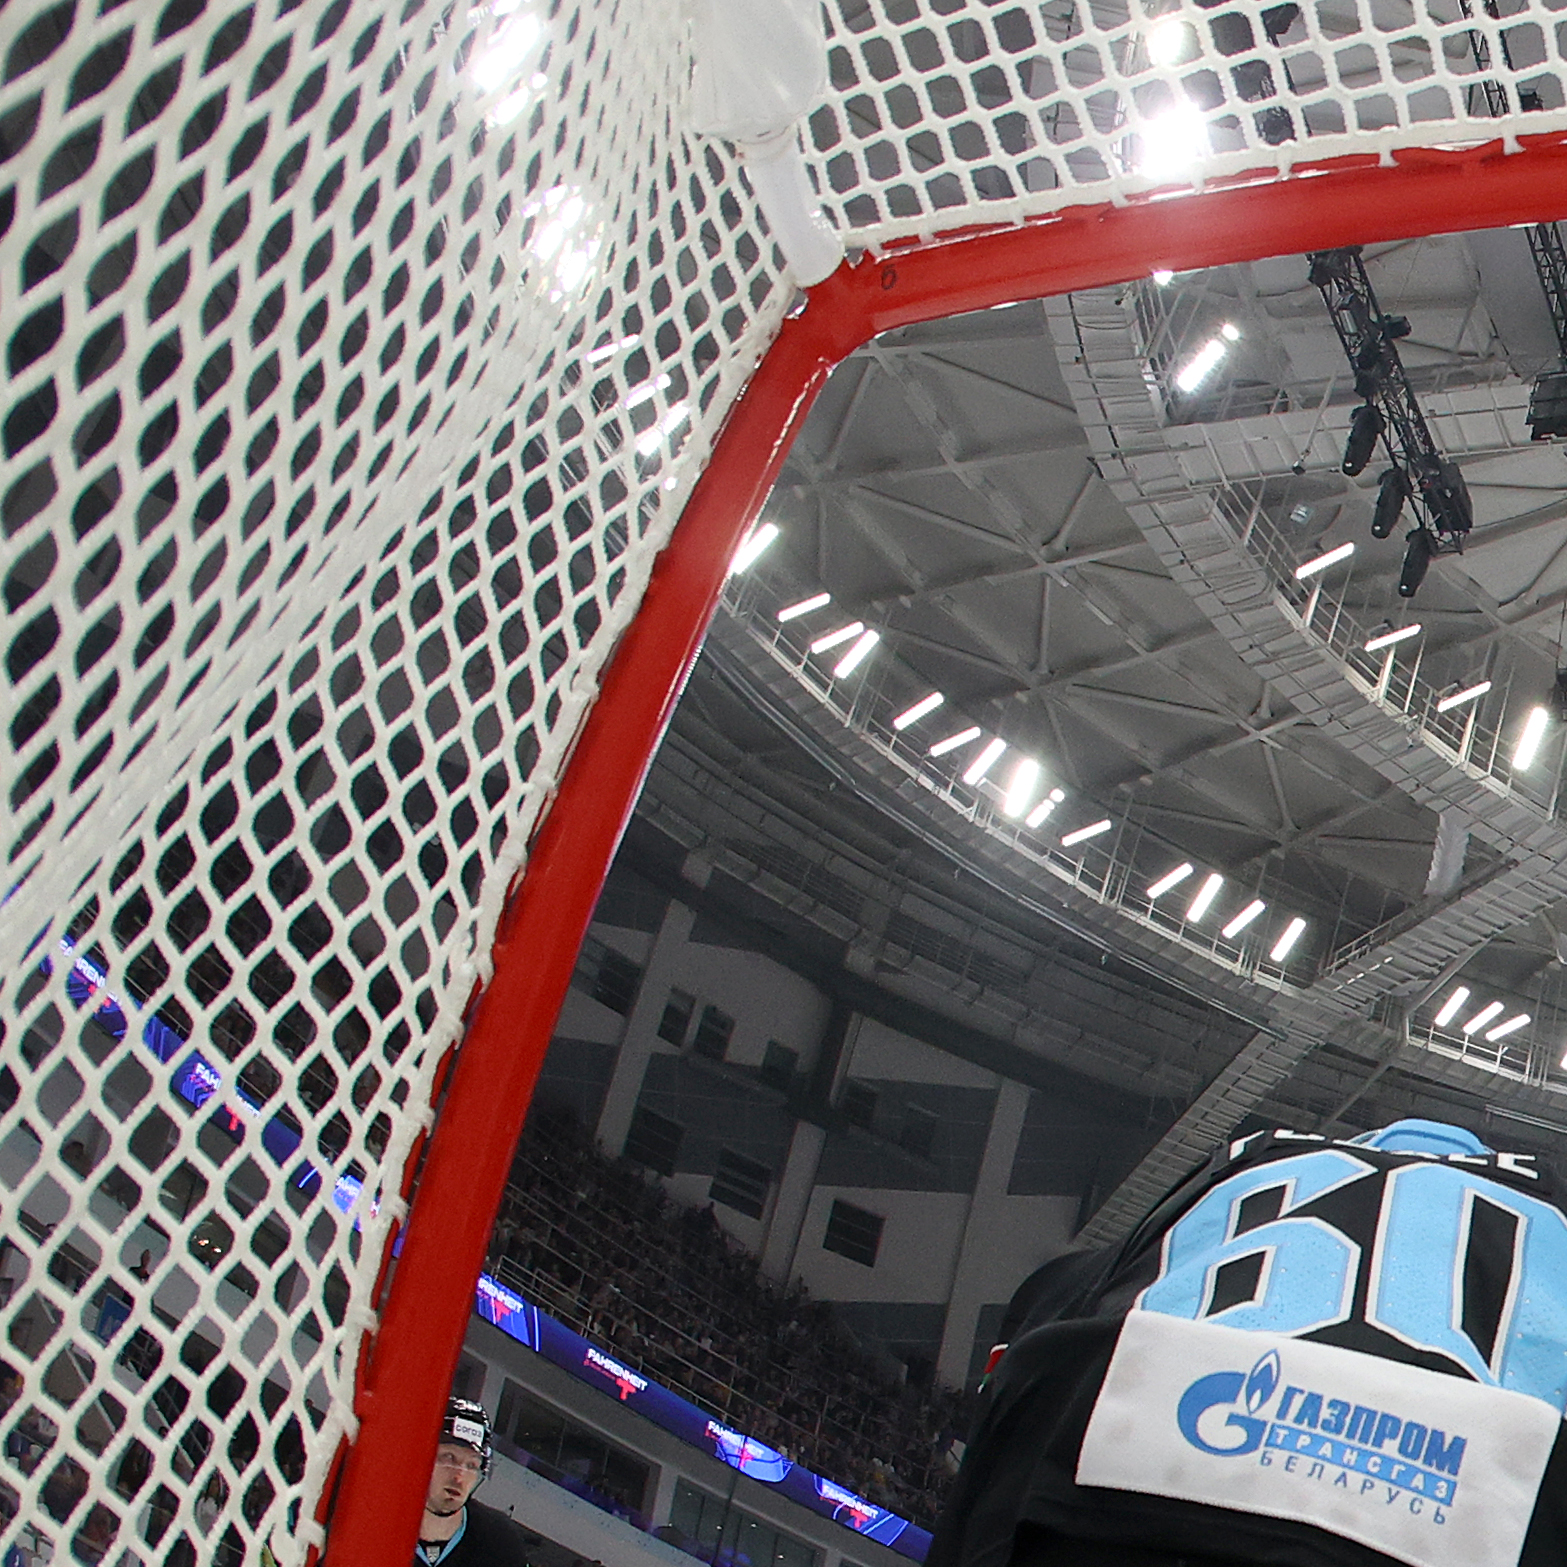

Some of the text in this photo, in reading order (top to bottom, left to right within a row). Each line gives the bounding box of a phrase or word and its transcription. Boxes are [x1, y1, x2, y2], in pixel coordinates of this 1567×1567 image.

[586, 1347, 649, 1392] FAHRENHEIT
[1273, 1428, 1449, 1499] ТРАНСГАЗ
[1275, 1385, 1468, 1477] ГАЗПРОМ
[1259, 1450, 1447, 1526] БЕЛАРУСЬ
